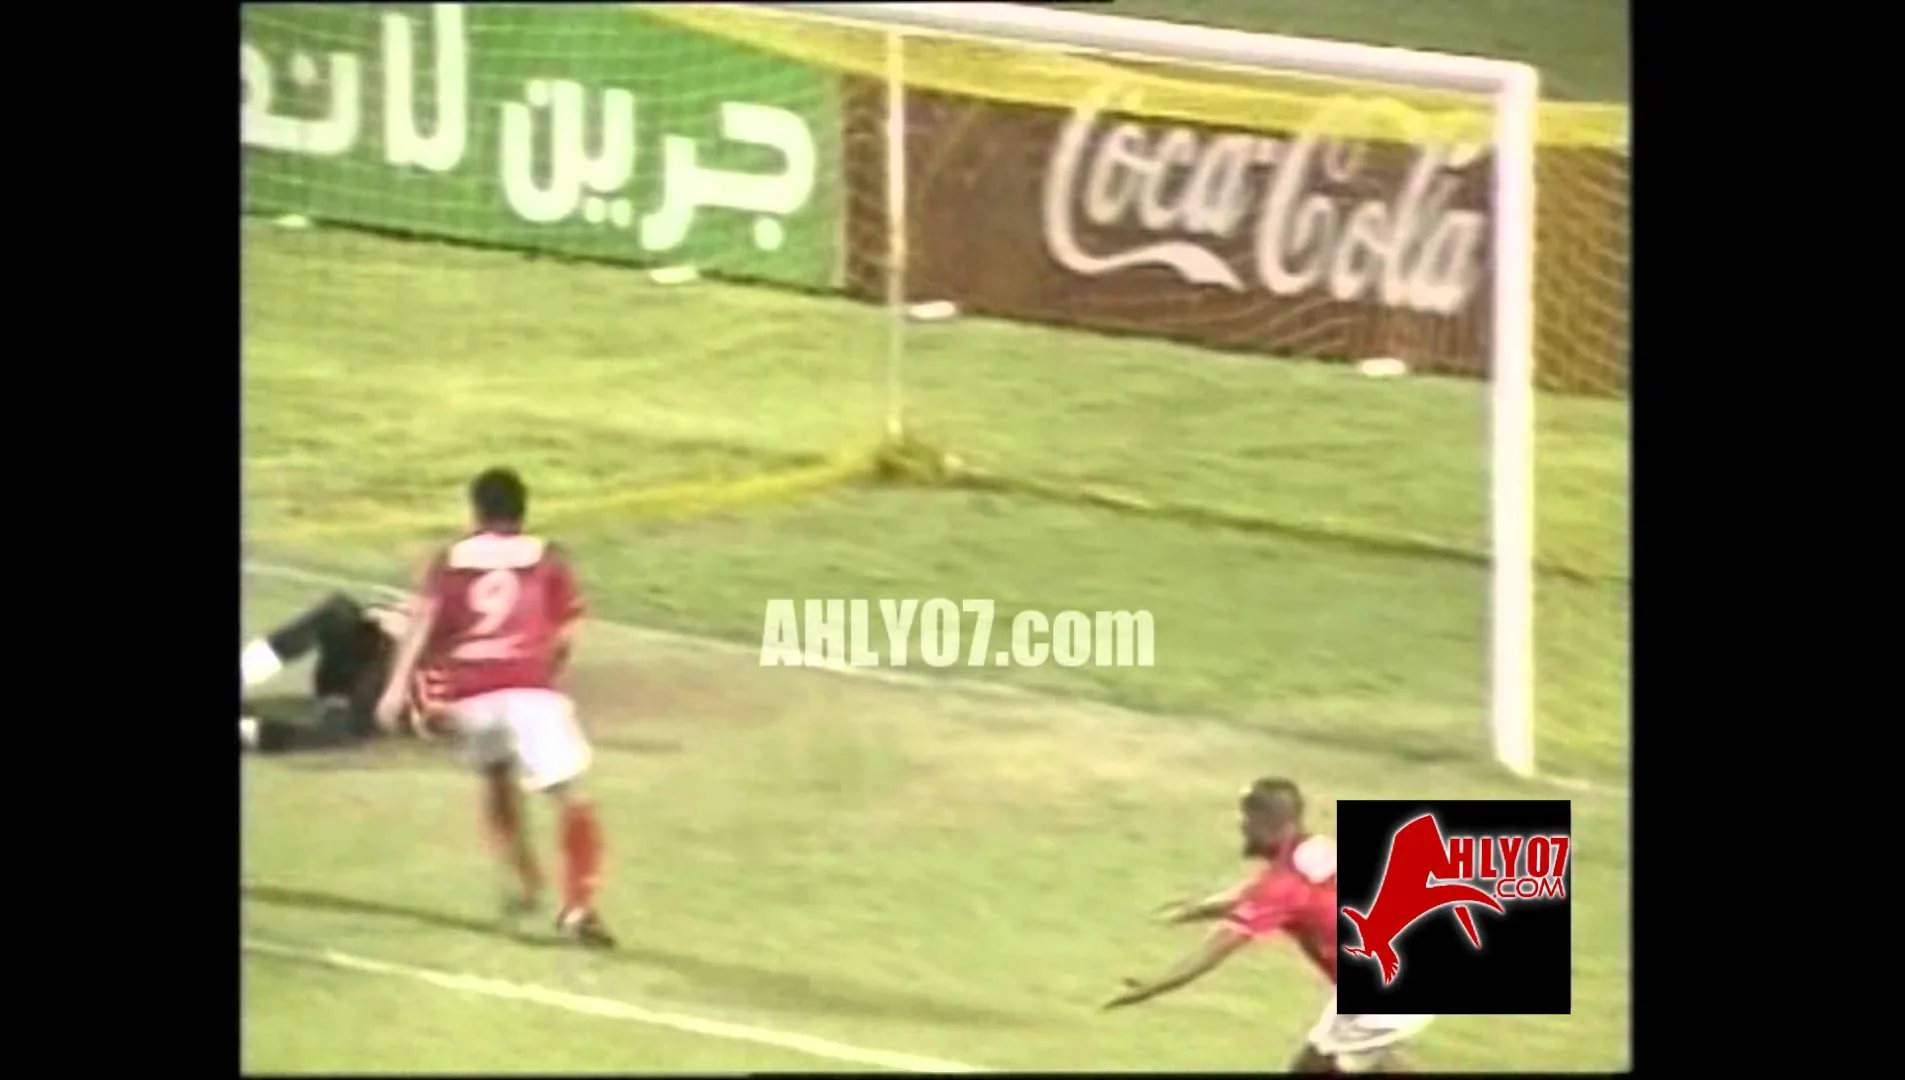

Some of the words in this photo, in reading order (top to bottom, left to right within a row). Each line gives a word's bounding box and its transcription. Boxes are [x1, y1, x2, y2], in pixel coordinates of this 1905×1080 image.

[501, 78, 817, 251] جرين
[1044, 82, 1486, 315] Coca-Cola
[467, 568, 521, 636] 9
